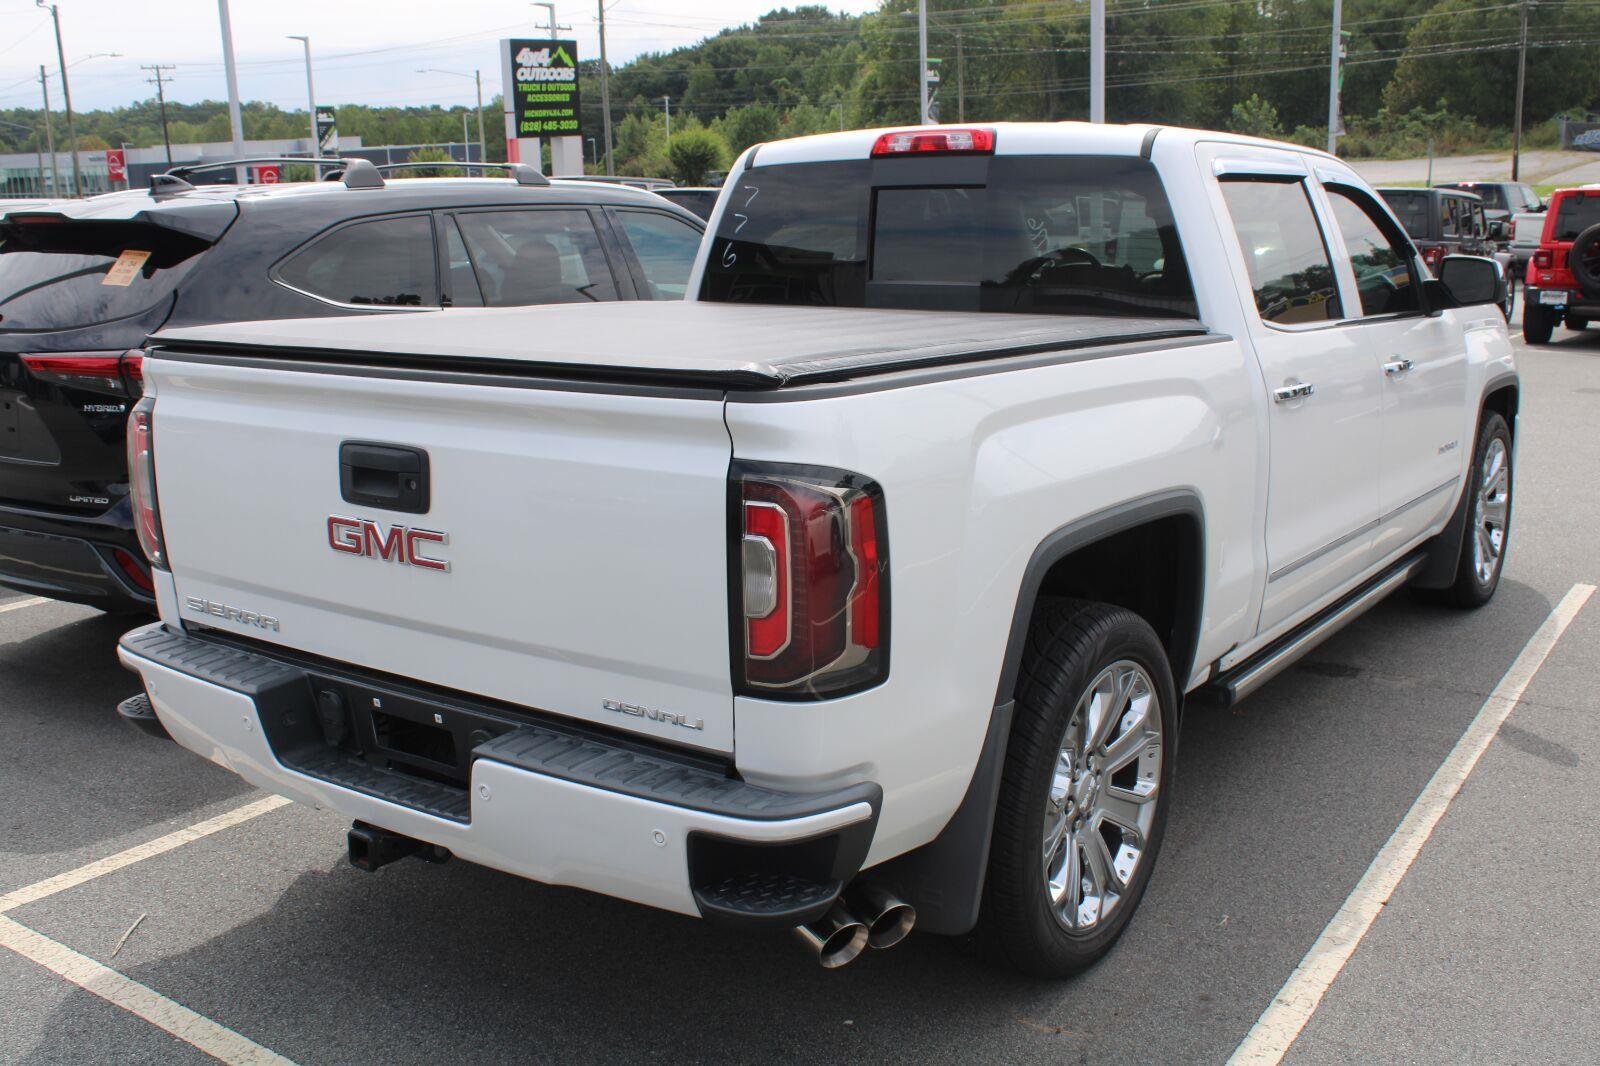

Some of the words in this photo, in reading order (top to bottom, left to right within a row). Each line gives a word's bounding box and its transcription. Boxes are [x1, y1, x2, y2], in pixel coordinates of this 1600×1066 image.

[516, 67, 575, 81] OUTDOORS
[518, 83, 541, 92] TRUCK
[547, 83, 577, 92] OUTDOOR
[527, 94, 570, 102] ACCESSORIES
[83, 404, 119, 412] HYBRID
[69, 495, 109, 504] LIMITED
[327, 514, 451, 573] GMC
[185, 595, 280, 632] SIERRA
[601, 697, 704, 731] DENALI
